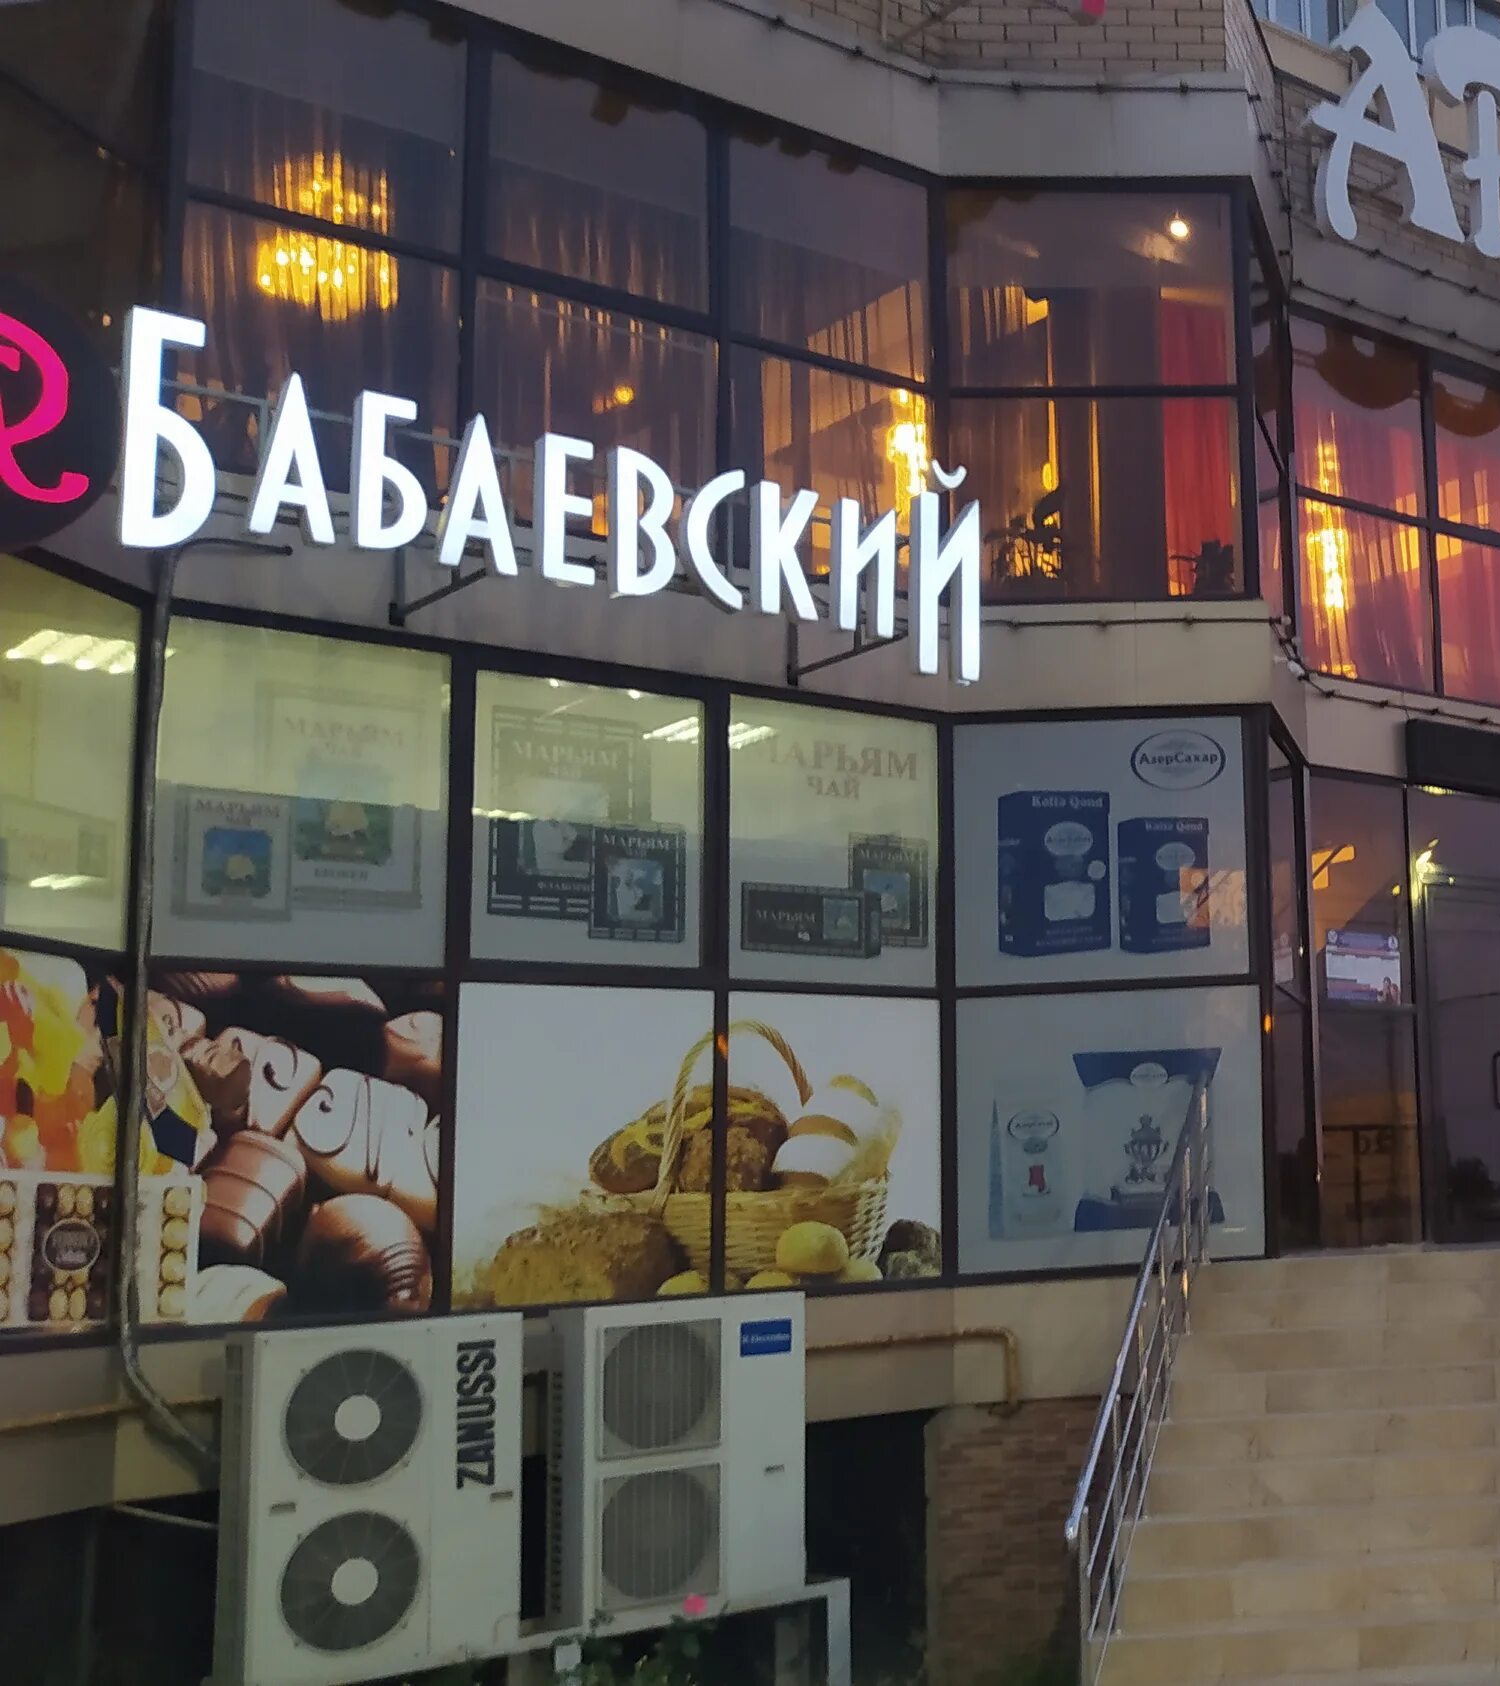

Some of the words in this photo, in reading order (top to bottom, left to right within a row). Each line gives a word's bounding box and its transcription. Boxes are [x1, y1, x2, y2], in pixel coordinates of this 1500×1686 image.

[119, 303, 982, 686] БАБАЕВСКИЙ
[1139, 751, 1218, 766] АзерСахар
[455, 1339, 497, 1490] ZANUSSI
